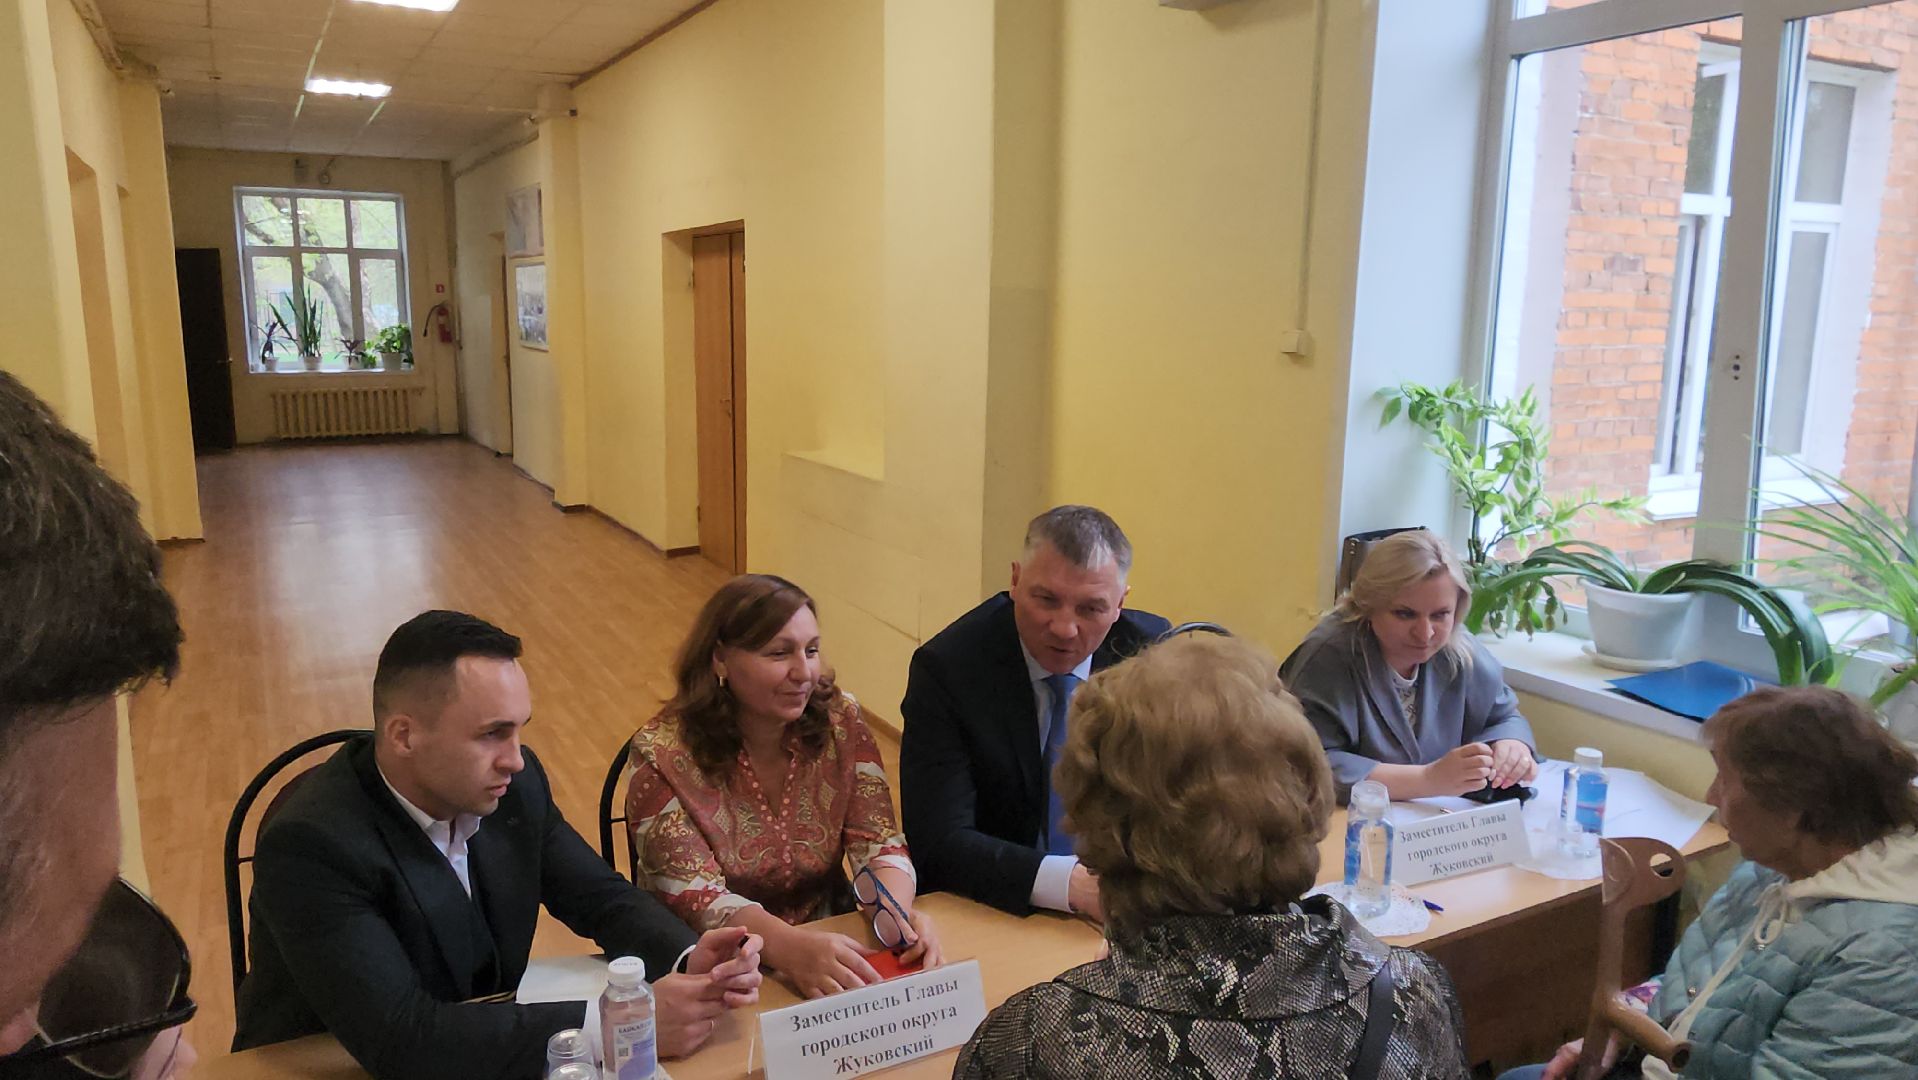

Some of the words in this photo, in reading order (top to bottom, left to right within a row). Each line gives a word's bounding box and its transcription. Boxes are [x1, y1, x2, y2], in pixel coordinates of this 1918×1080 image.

[1401, 821, 1469, 843] Заместитель
[1470, 814, 1507, 828] Главы
[1407, 841, 1468, 862] городского
[1471, 832, 1508, 848] округа
[1429, 853, 1495, 876] Жуковский
[790, 995, 901, 1032] Заместитель
[904, 979, 959, 1002] Главы
[801, 1021, 897, 1056] городского
[902, 1006, 958, 1029] округа
[833, 1034, 934, 1074] Жуковский
